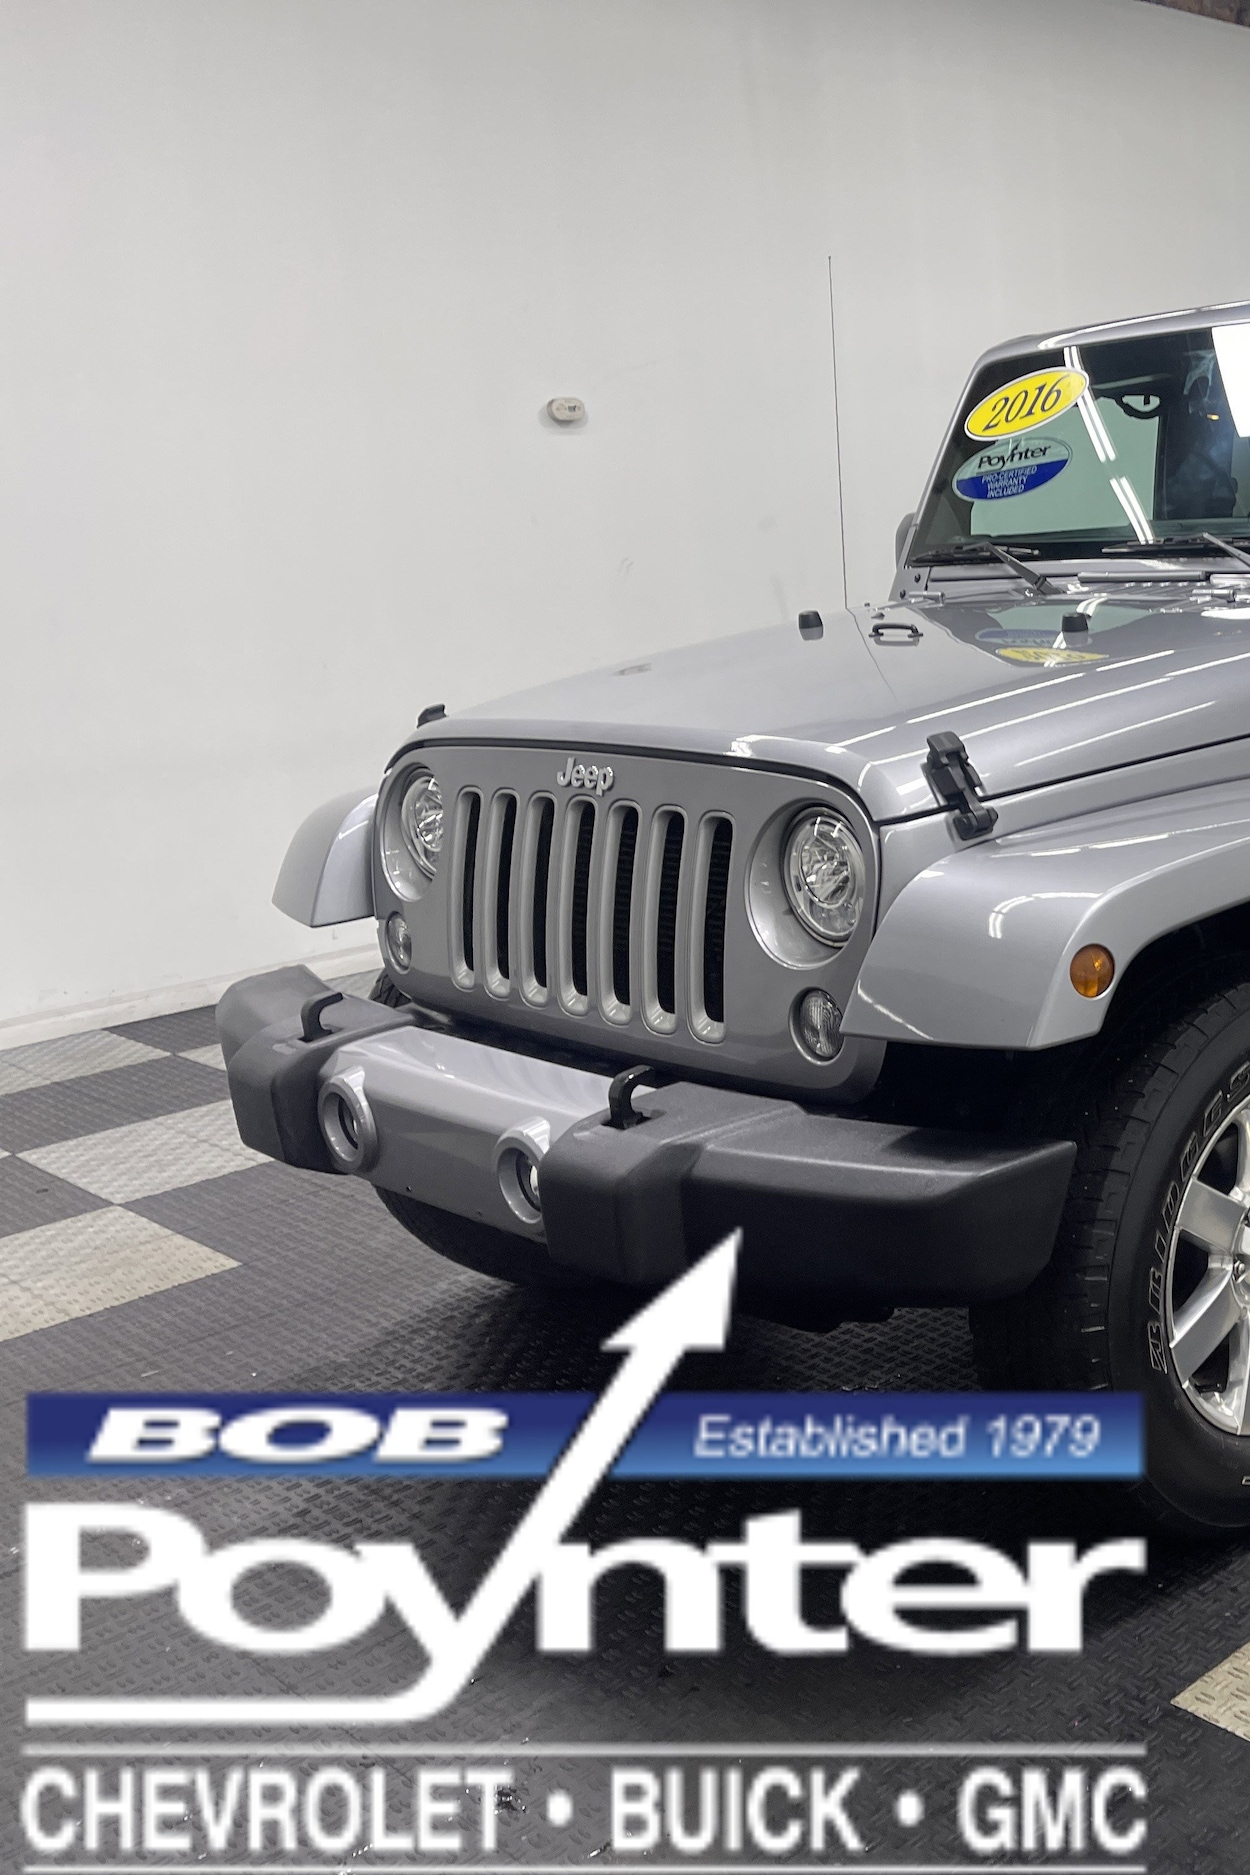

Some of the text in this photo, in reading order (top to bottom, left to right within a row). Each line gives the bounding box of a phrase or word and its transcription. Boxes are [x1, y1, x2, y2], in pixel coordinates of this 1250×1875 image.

[982, 375, 1070, 432] 2016
[978, 441, 1051, 471] Poynter
[986, 484, 1025, 499] INCLUDED
[557, 757, 614, 797] Jeep
